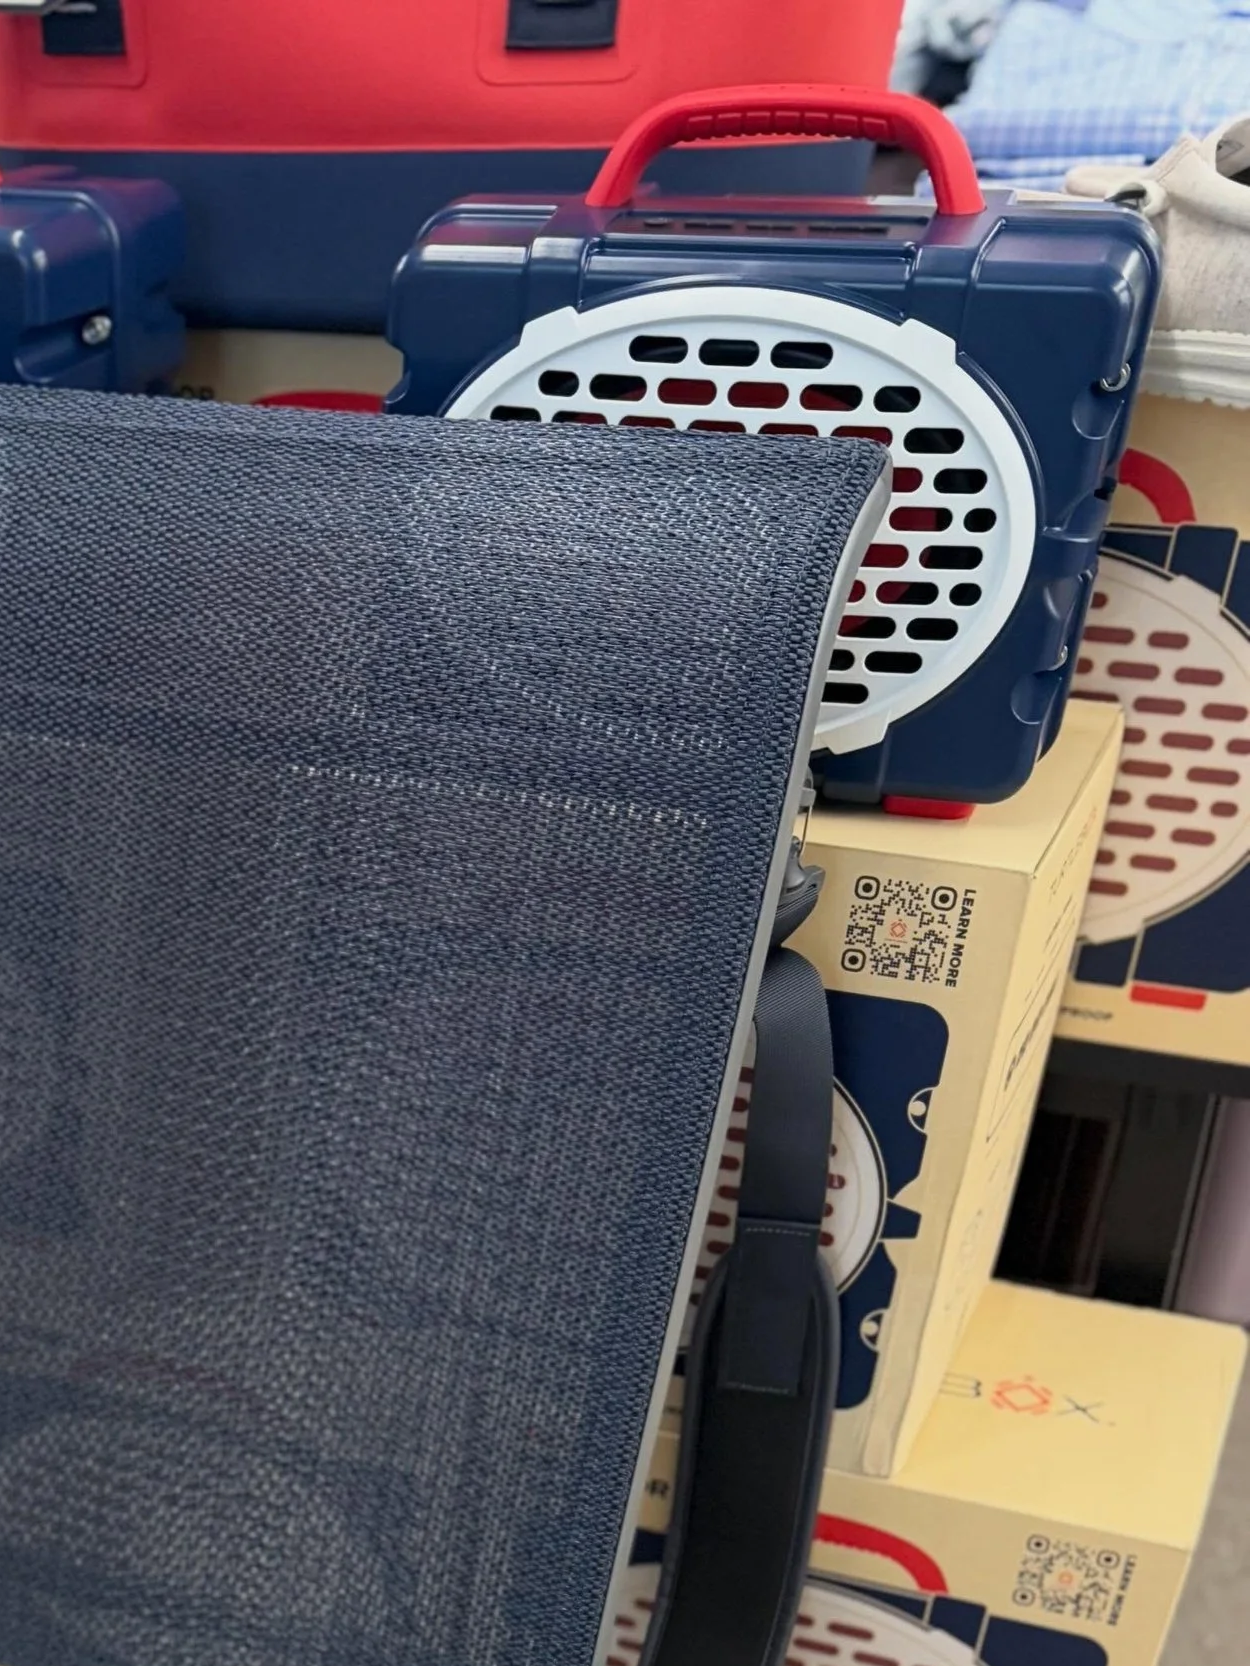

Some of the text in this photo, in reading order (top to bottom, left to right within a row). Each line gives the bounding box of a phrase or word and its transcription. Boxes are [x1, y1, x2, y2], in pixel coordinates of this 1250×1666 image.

[945, 888, 977, 987] LEARN MORE
[1107, 1554, 1138, 1626] LEARN MORE
